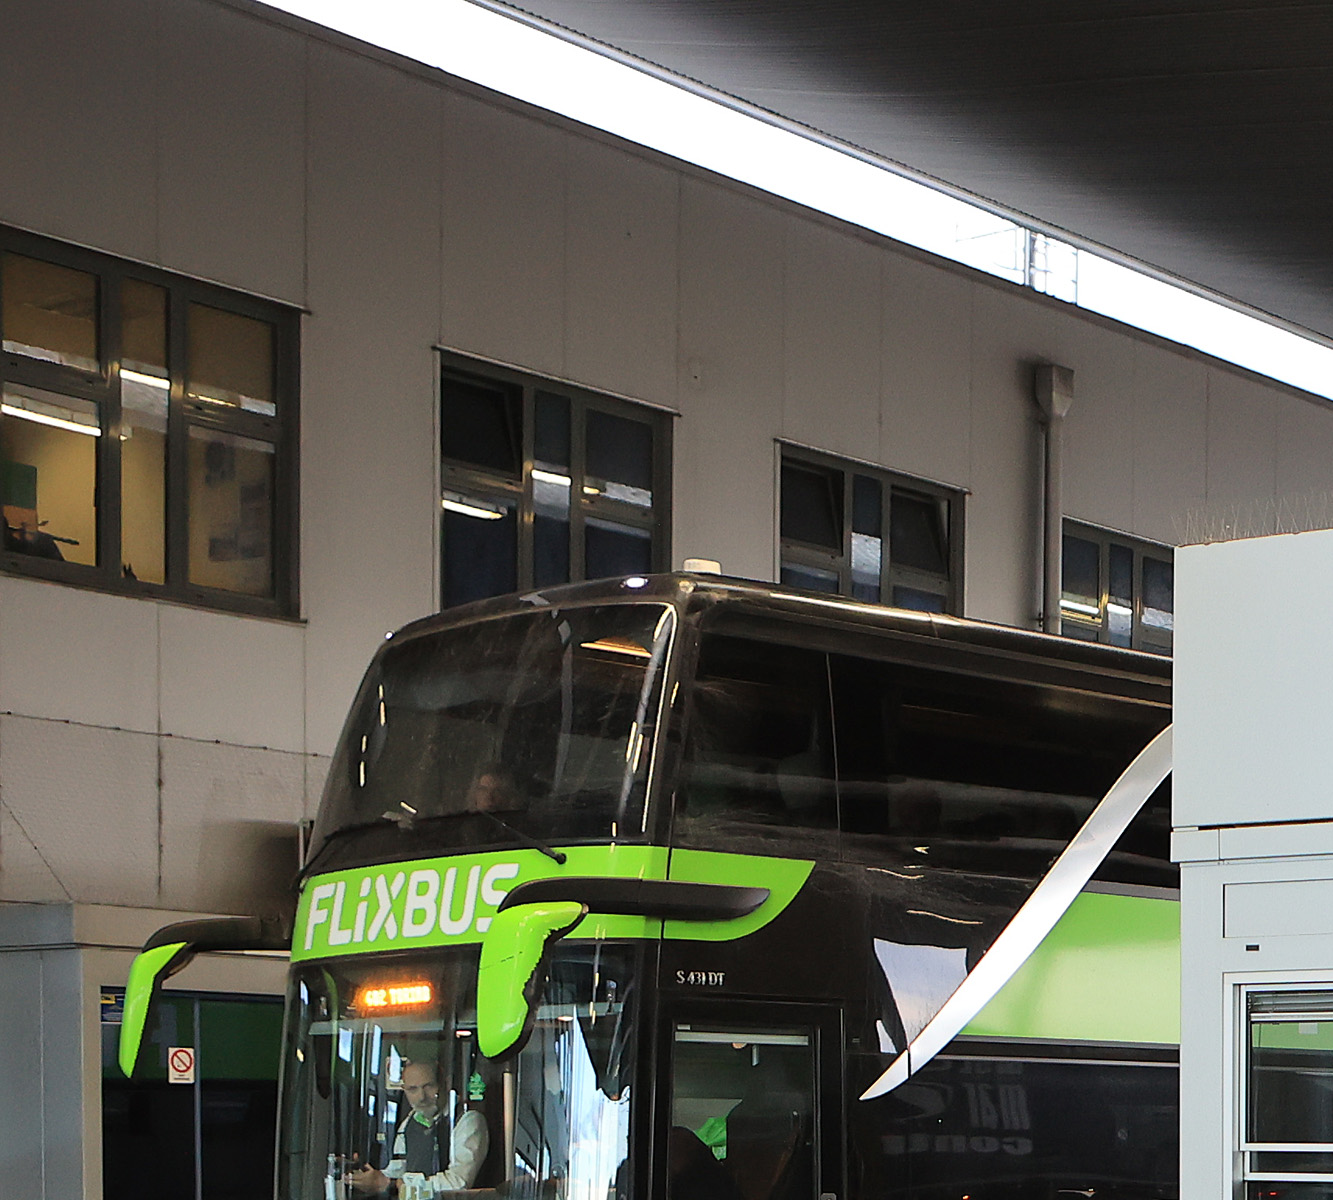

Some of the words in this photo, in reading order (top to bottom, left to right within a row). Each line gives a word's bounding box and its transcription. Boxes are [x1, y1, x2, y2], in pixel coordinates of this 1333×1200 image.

[676, 970, 685, 984] S
[687, 971, 706, 986] 431
[708, 972, 726, 986] DT
